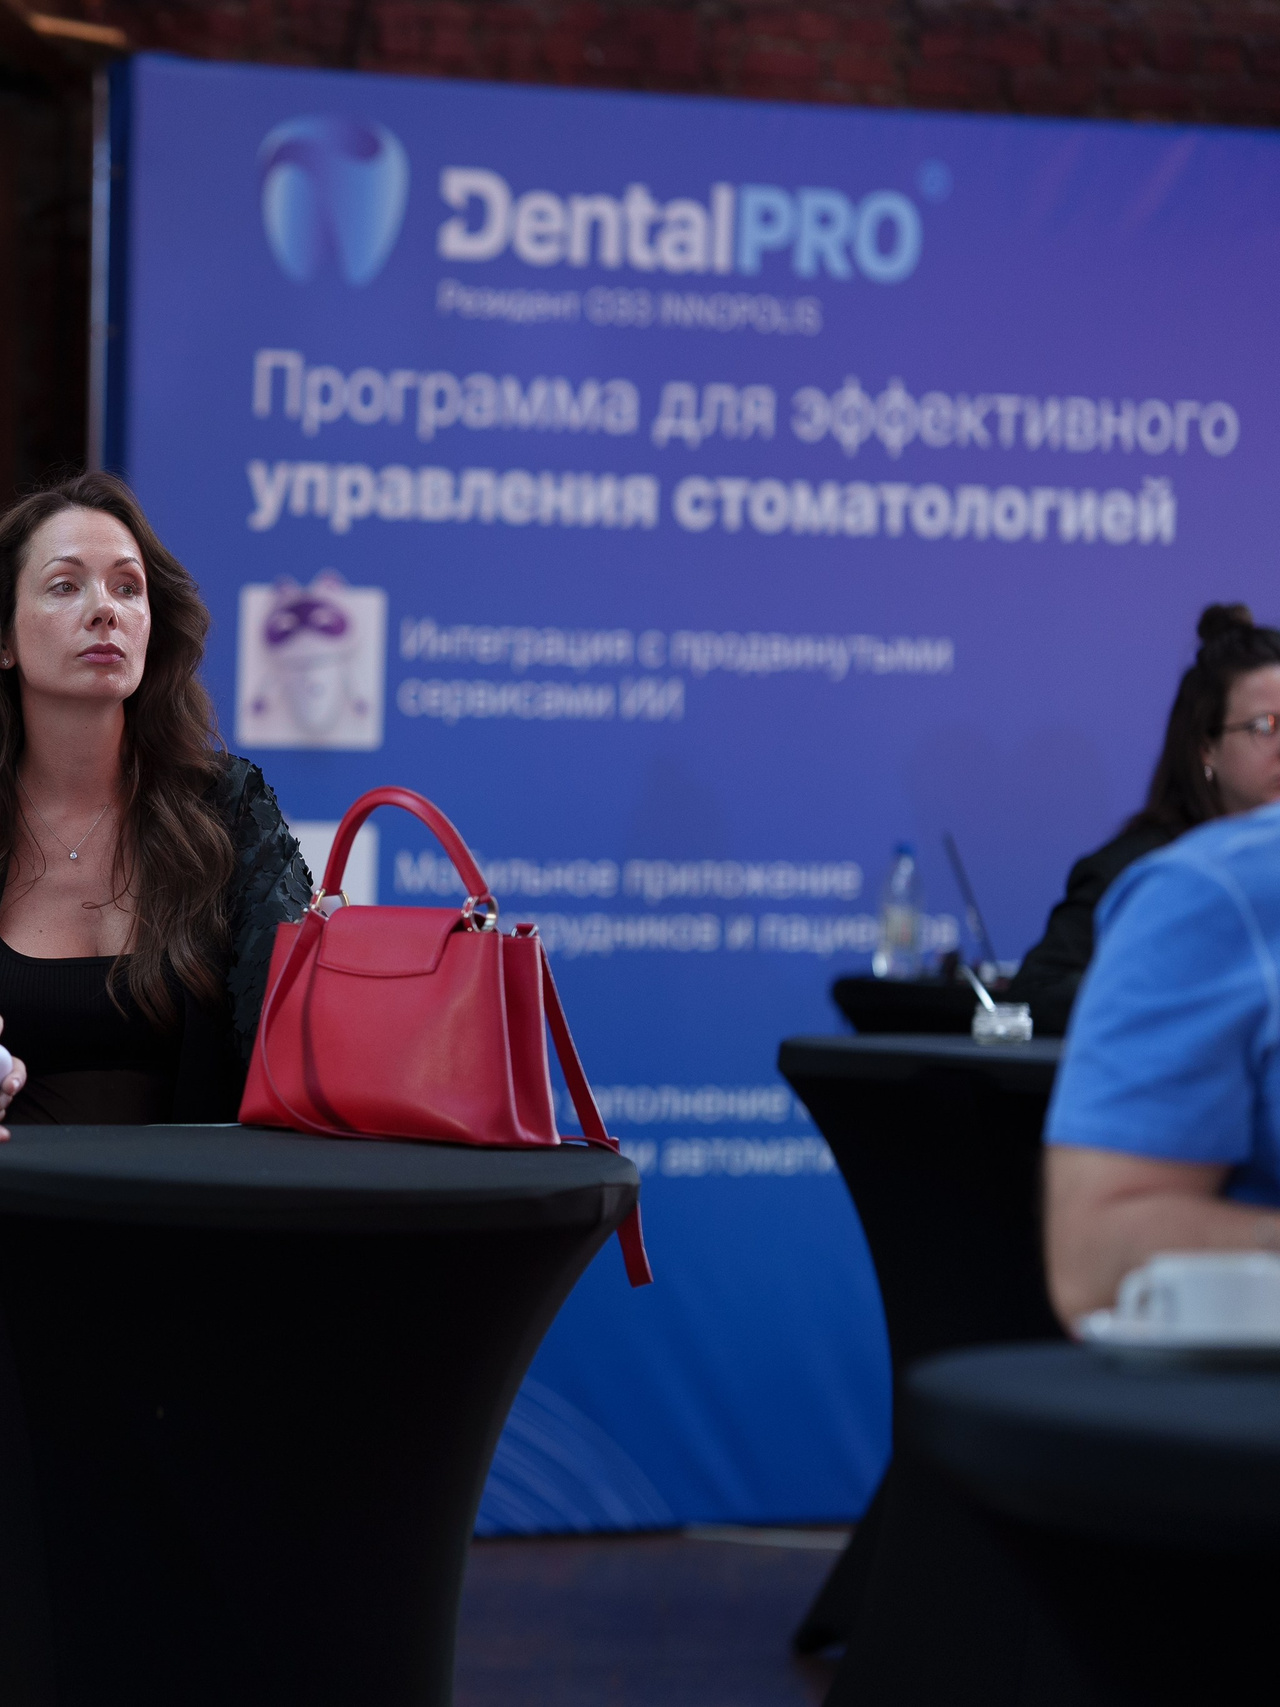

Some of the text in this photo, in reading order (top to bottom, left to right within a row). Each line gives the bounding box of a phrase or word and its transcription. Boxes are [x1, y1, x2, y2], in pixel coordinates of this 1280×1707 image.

[439, 166, 920, 283] DentalPRO
[252, 348, 1240, 460] Программа для эффективного
[246, 459, 1179, 547] управления стоматологией
[400, 615, 954, 683] Интеграция с продвинутыми
[397, 677, 615, 727] сервисами
[623, 857, 863, 905] приложение
[723, 913, 756, 952] и
[757, 911, 960, 959] пациеов
